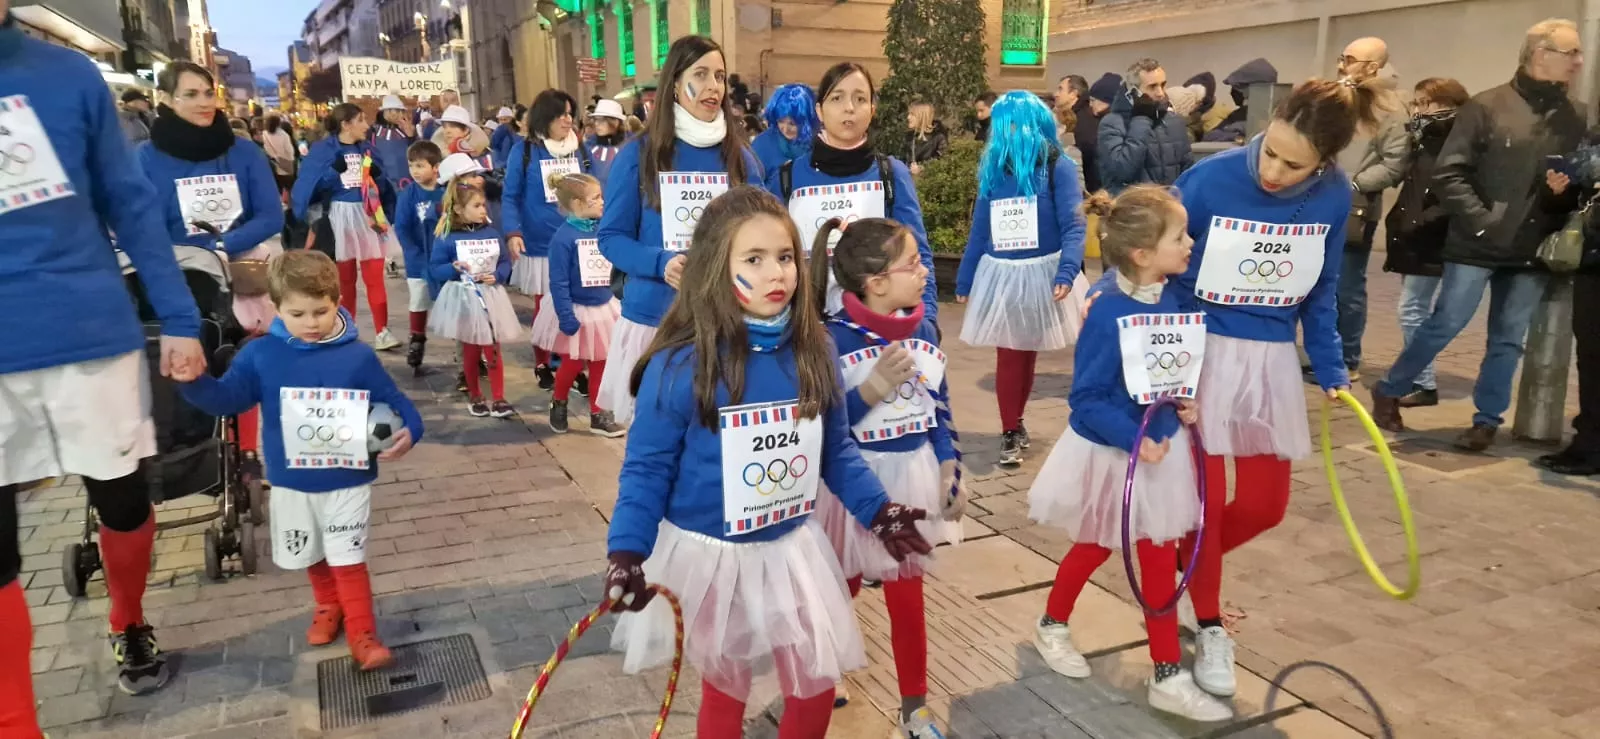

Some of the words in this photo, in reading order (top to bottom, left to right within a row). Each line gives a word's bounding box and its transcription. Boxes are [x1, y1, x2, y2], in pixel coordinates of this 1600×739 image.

[347, 64, 380, 75] CEIP
[388, 63, 442, 74] ALCORAZ
[350, 79, 389, 91] AMYPA
[400, 80, 443, 90] LORETO
[680, 190, 713, 201] 2024
[821, 199, 853, 211] 2024
[1002, 208, 1024, 217] 2024
[1252, 241, 1291, 254] 2024
[1150, 333, 1183, 345] 2024
[305, 407, 346, 418] 2024
[752, 430, 801, 452] 2024
